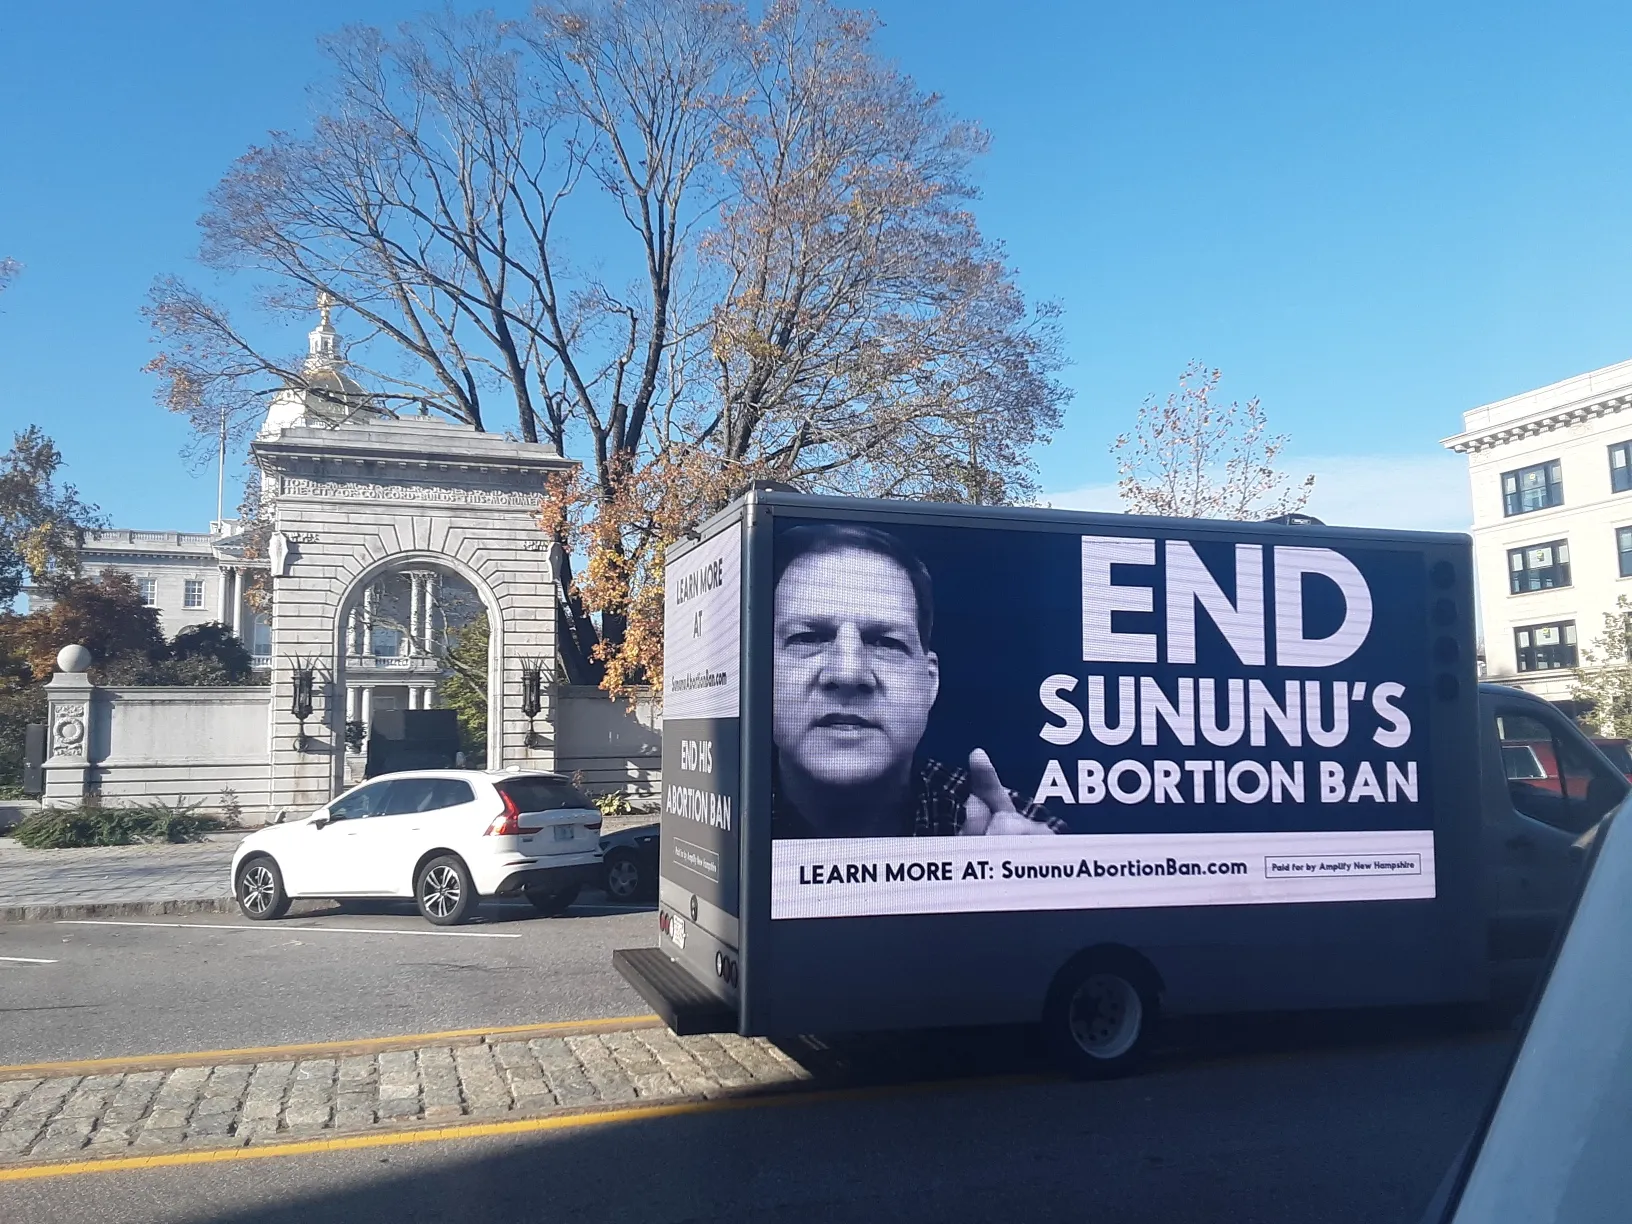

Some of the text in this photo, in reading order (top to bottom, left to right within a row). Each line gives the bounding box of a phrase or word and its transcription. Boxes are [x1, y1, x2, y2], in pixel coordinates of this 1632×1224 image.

[490, 496, 541, 507] MONUMEN
[676, 557, 723, 605] LEARN MORE
[1081, 535, 1373, 668] END
[693, 609, 703, 638] AT
[1039, 673, 1412, 749] SUNUNU'S
[681, 740, 713, 774] END HIS
[1033, 758, 1419, 804] ABORTION BAN
[665, 784, 731, 831] ABORTION BAN
[799, 857, 1248, 885] LEARN MORE AT: SununuAbortionBan.com
[1271, 860, 1415, 873] Paid for by Amplify New Hampshire
